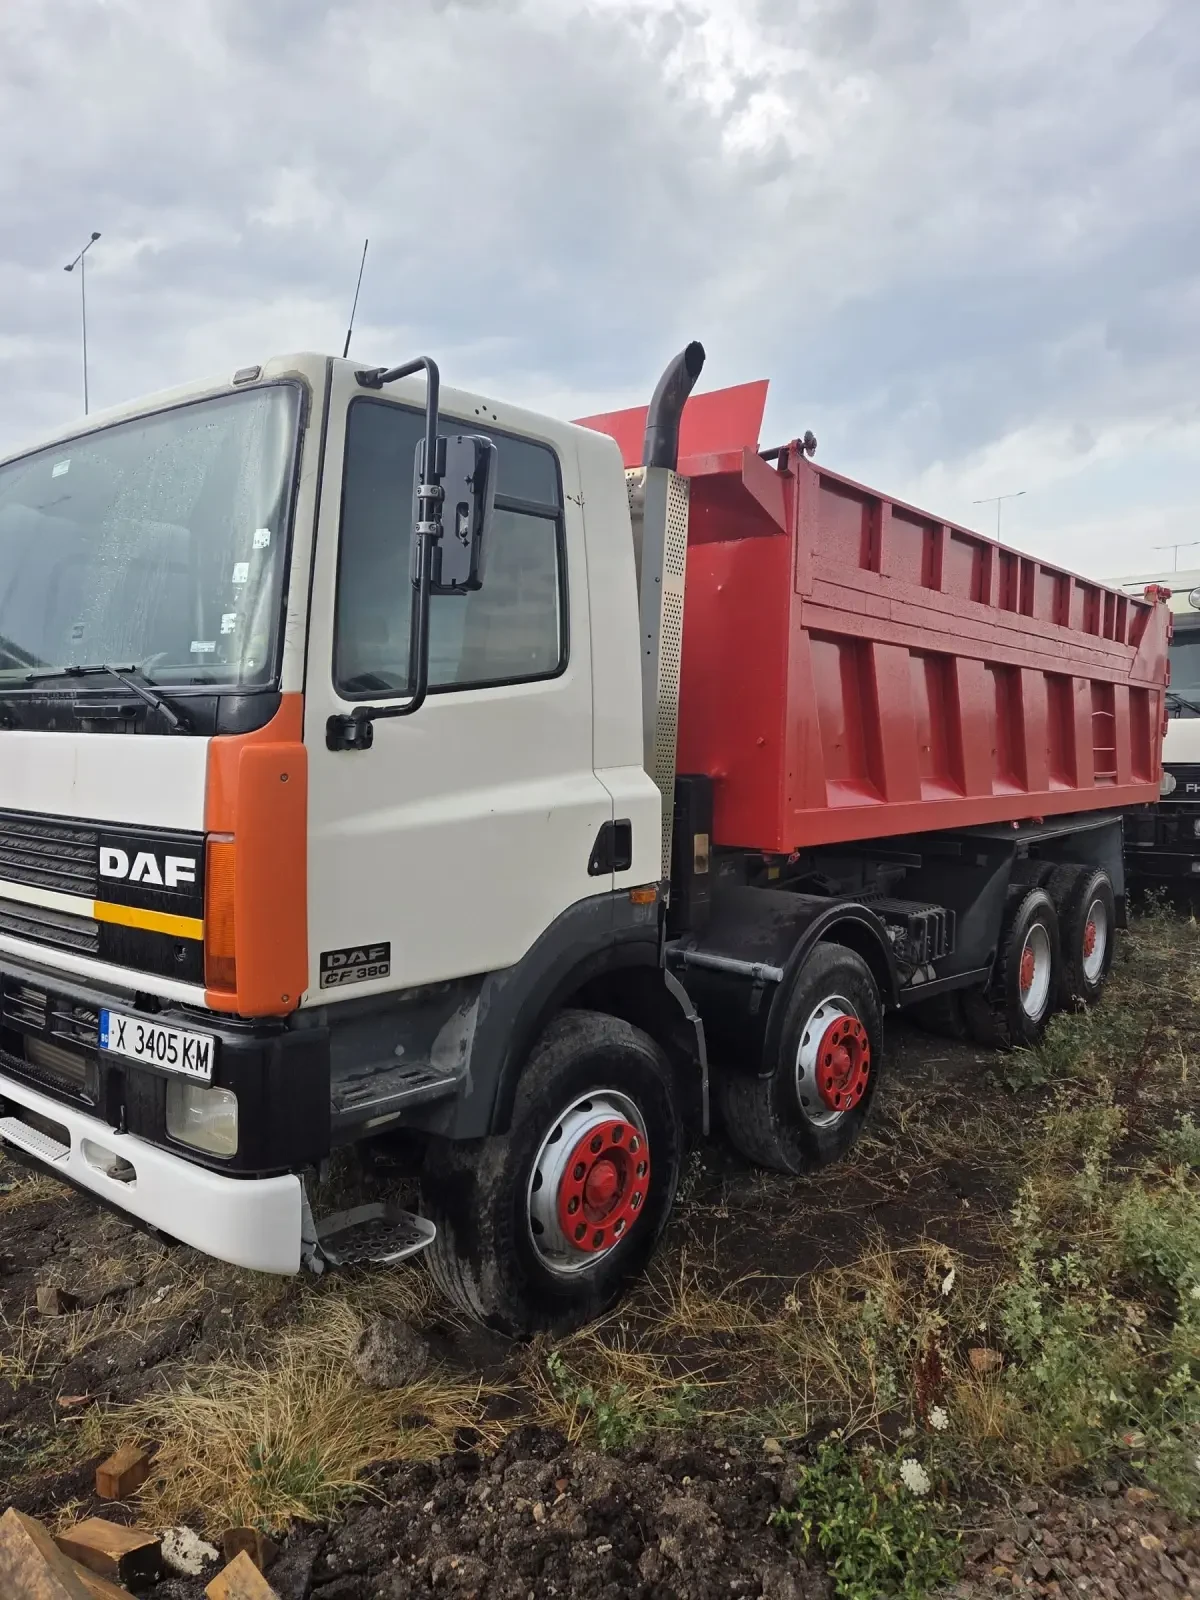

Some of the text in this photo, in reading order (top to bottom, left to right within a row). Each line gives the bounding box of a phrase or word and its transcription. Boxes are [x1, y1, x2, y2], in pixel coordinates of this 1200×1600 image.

[99, 846, 196, 888] DAF
[327, 947, 385, 968] DAF
[324, 964, 389, 984] CF 380
[134, 1025, 178, 1064] 3405
